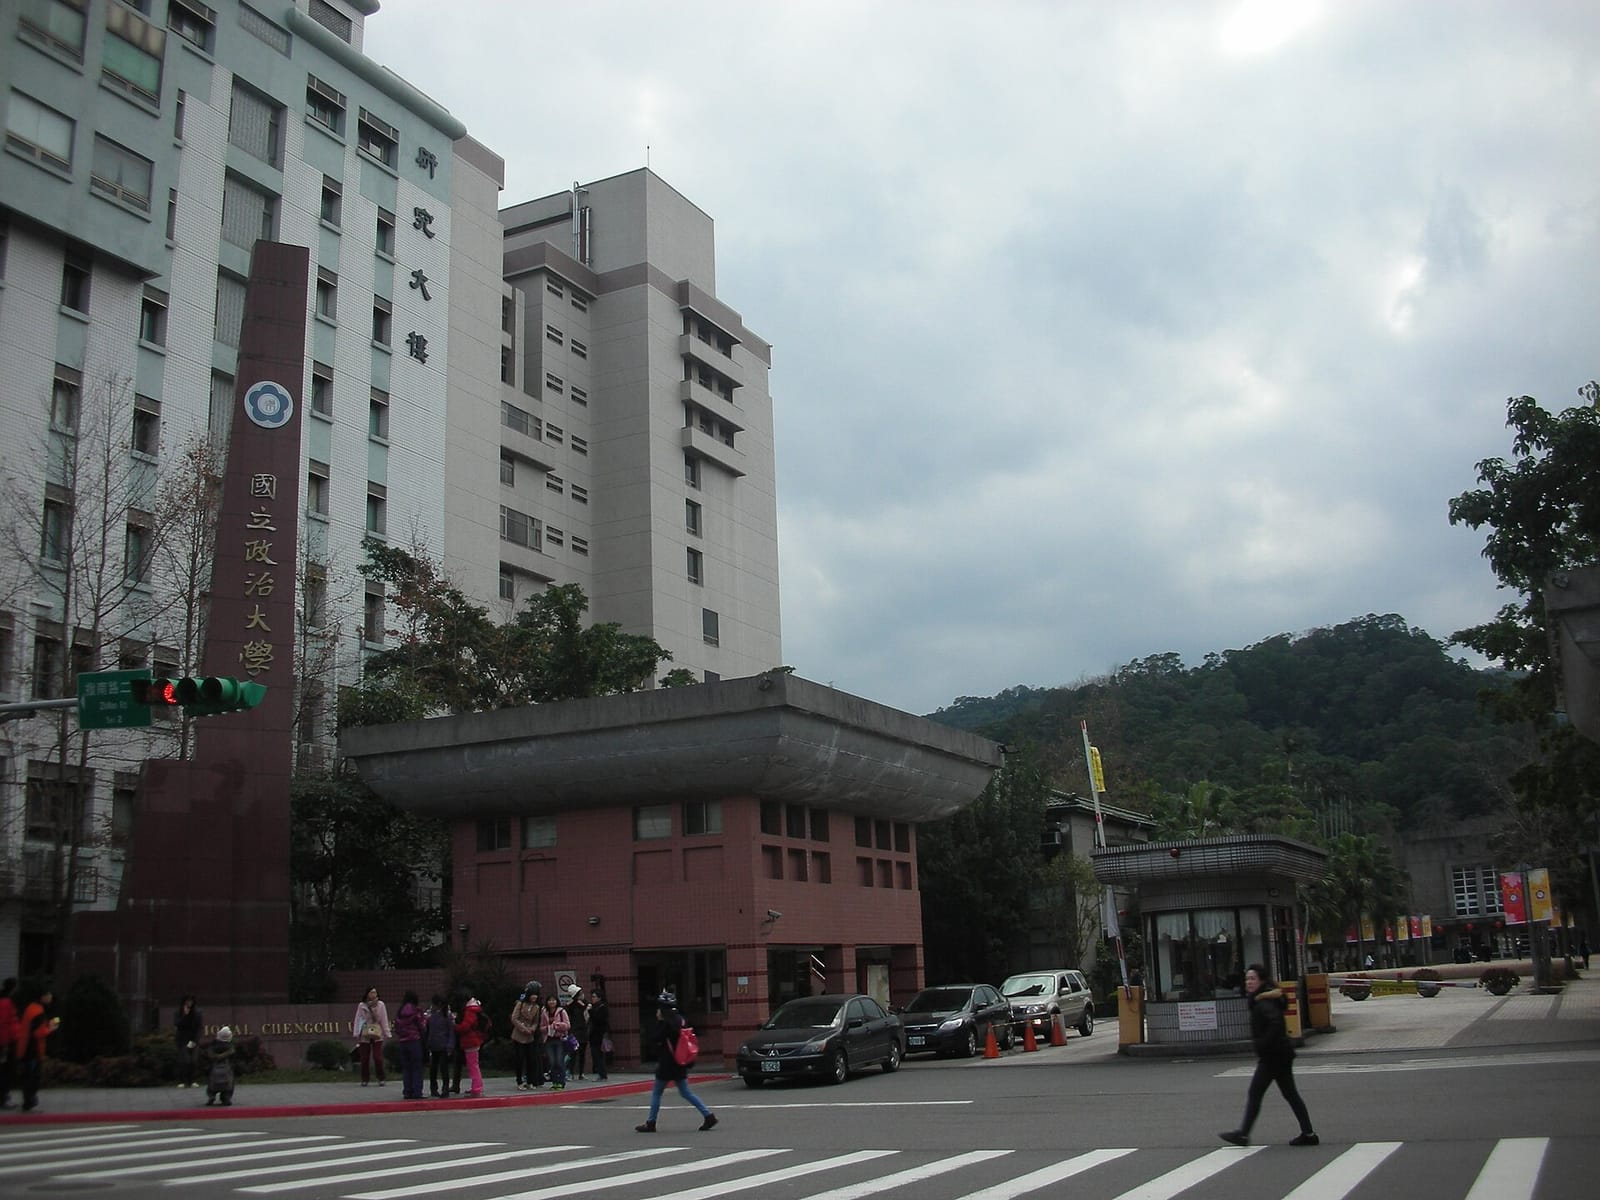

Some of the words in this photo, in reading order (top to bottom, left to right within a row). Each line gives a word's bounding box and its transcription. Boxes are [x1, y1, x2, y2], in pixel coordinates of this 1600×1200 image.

[406, 147, 438, 363] 研究大樓
[239, 473, 277, 676] 國立政治大學
[262, 1022, 340, 1035] CHENGCHI
